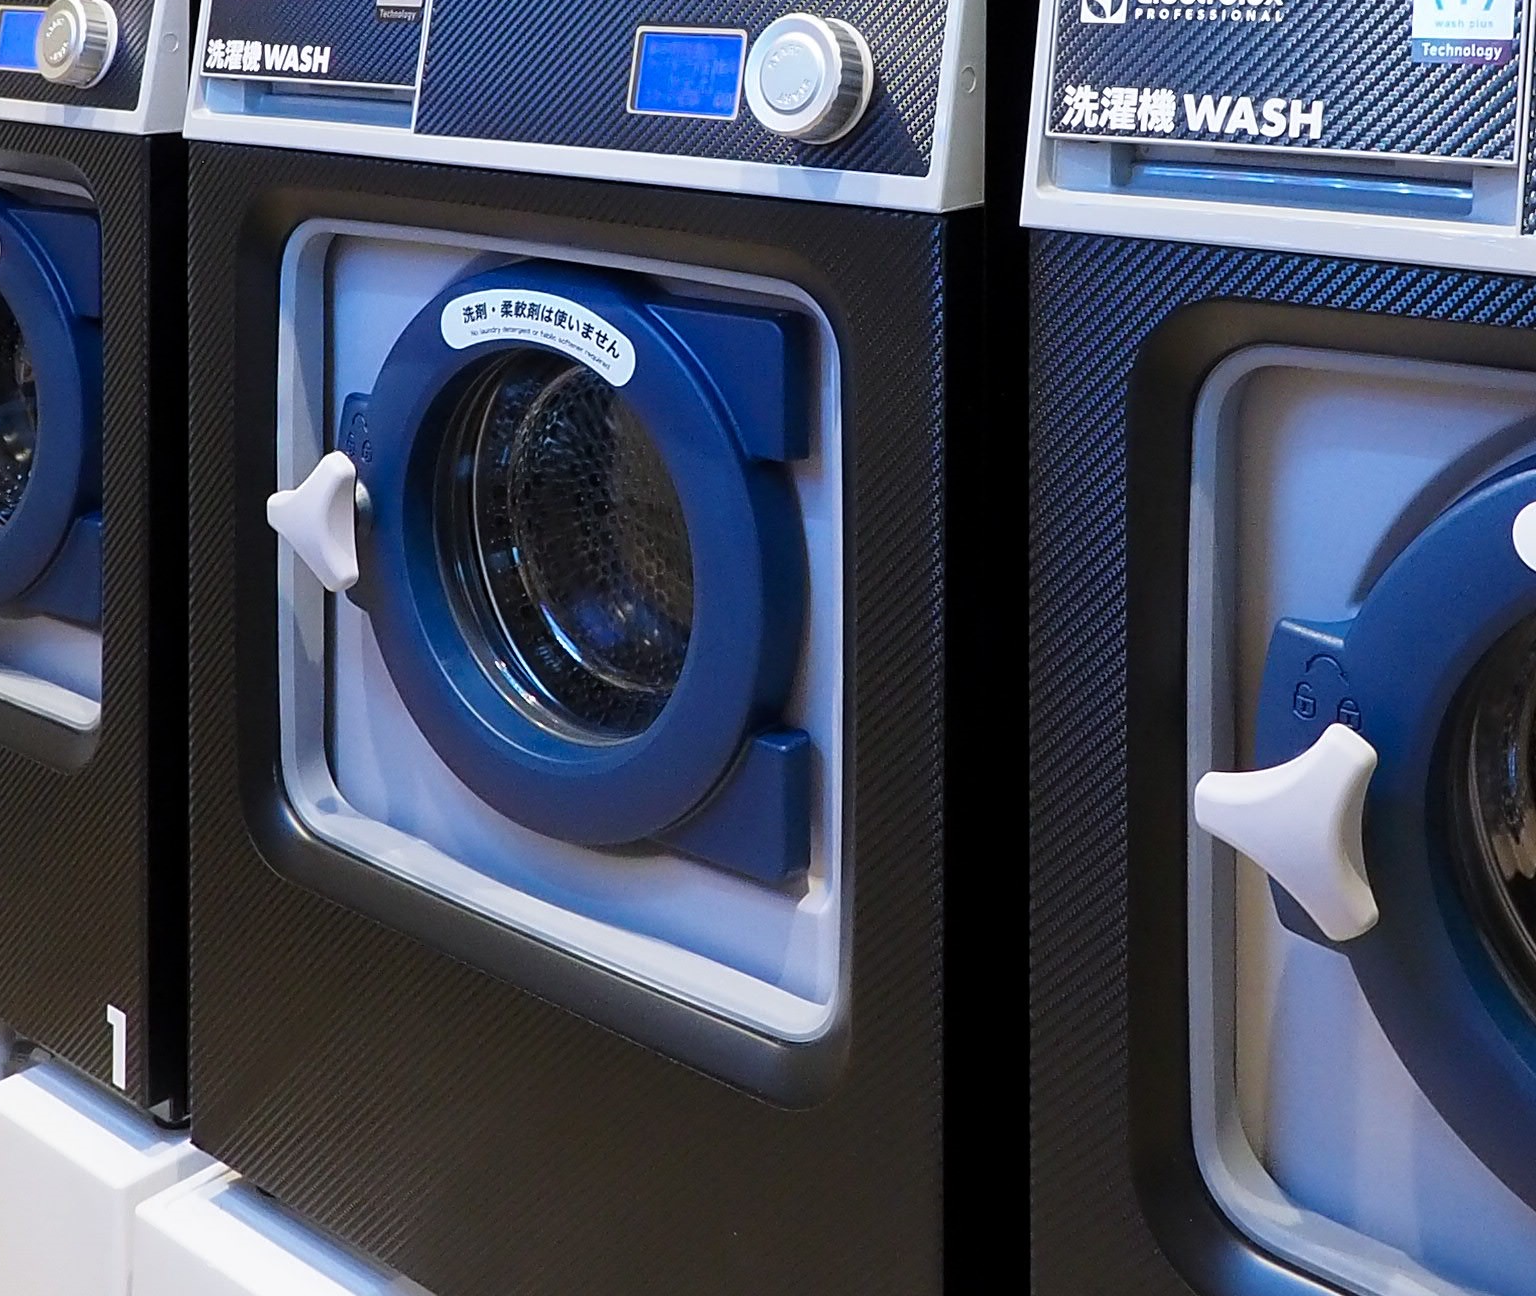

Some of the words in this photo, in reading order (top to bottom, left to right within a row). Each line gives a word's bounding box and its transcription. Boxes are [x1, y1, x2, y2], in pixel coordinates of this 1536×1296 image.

[1134, 7, 1284, 22] PROFESSIONAL
[206, 39, 262, 71] 洗濯機
[264, 43, 332, 74] WASH
[1421, 42, 1503, 60] Technology
[1061, 84, 1177, 134] 洗濯機
[1183, 93, 1324, 140] WASH
[462, 300, 620, 359] 洗剤・柔軟剤は使いません
[107, 1003, 127, 1091] 1
